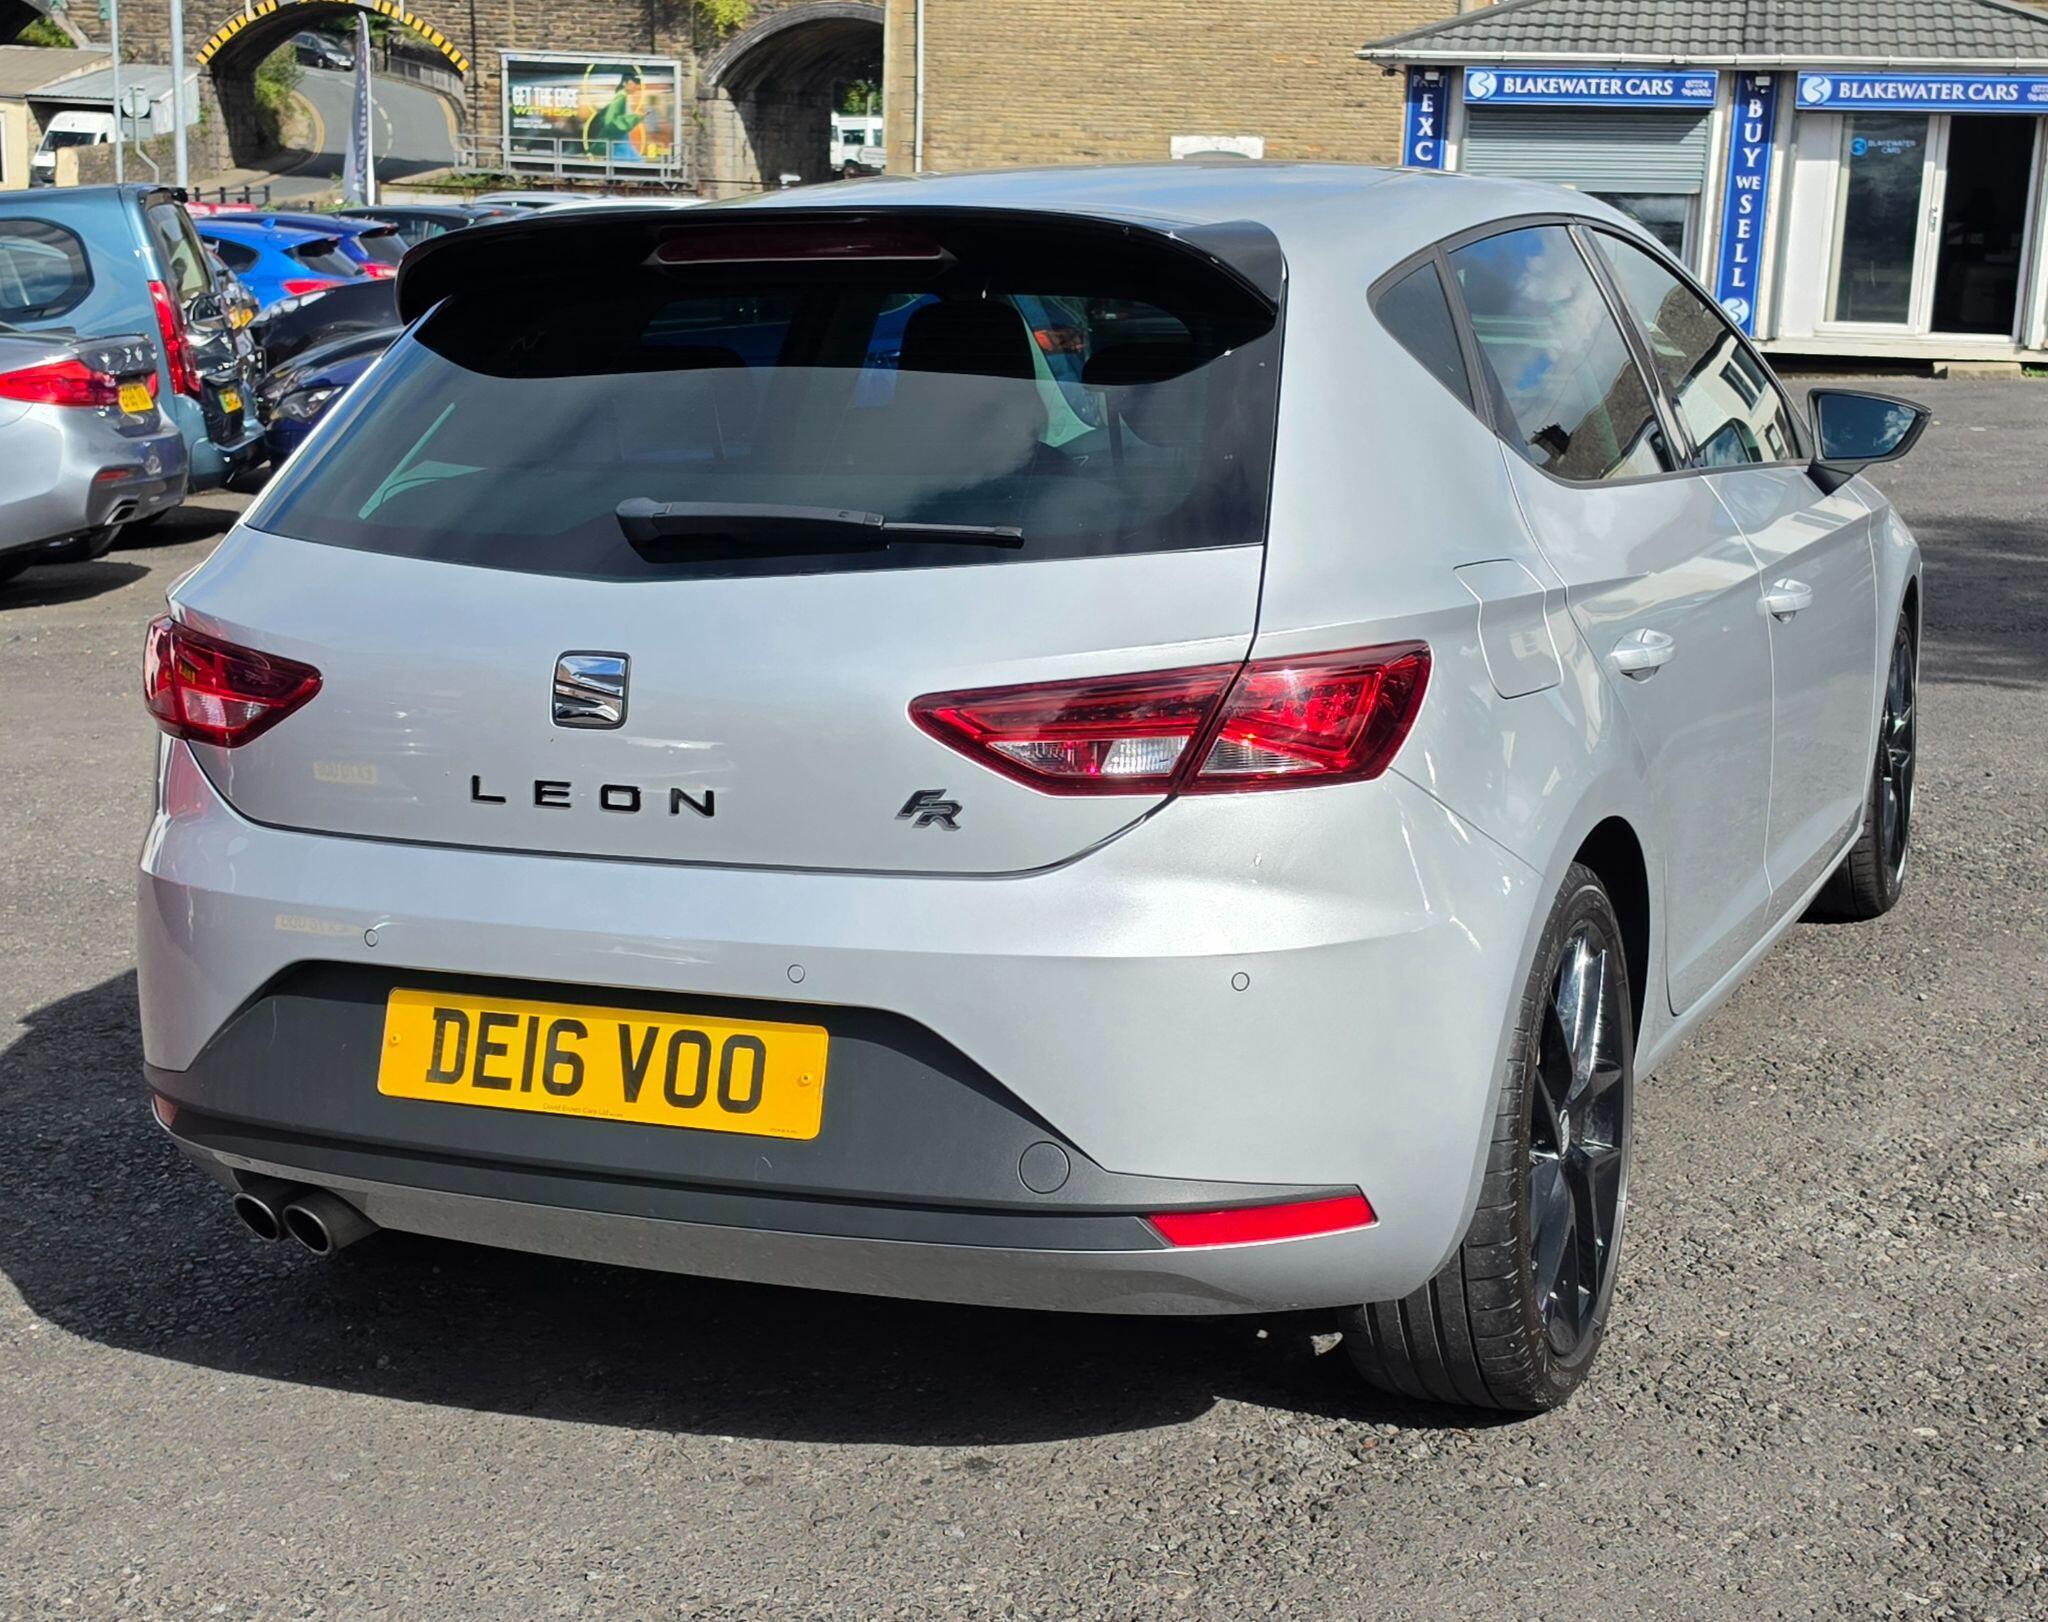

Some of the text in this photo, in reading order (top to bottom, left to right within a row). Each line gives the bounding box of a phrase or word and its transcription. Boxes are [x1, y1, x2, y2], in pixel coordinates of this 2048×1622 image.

[512, 86, 532, 106] GET
[533, 87, 553, 107] THE
[1503, 77, 1673, 96] BLAKEWATER CARS
[1839, 81, 2019, 101] BLAKEWATER CARS
[513, 105, 553, 116] WITH
[1743, 99, 1763, 168] BUY
[1735, 176, 1761, 190] WE
[1732, 194, 1752, 287] SELL
[470, 775, 715, 818] LEON
[894, 788, 963, 831] FR
[425, 1006, 767, 1115] DE16 VOO
